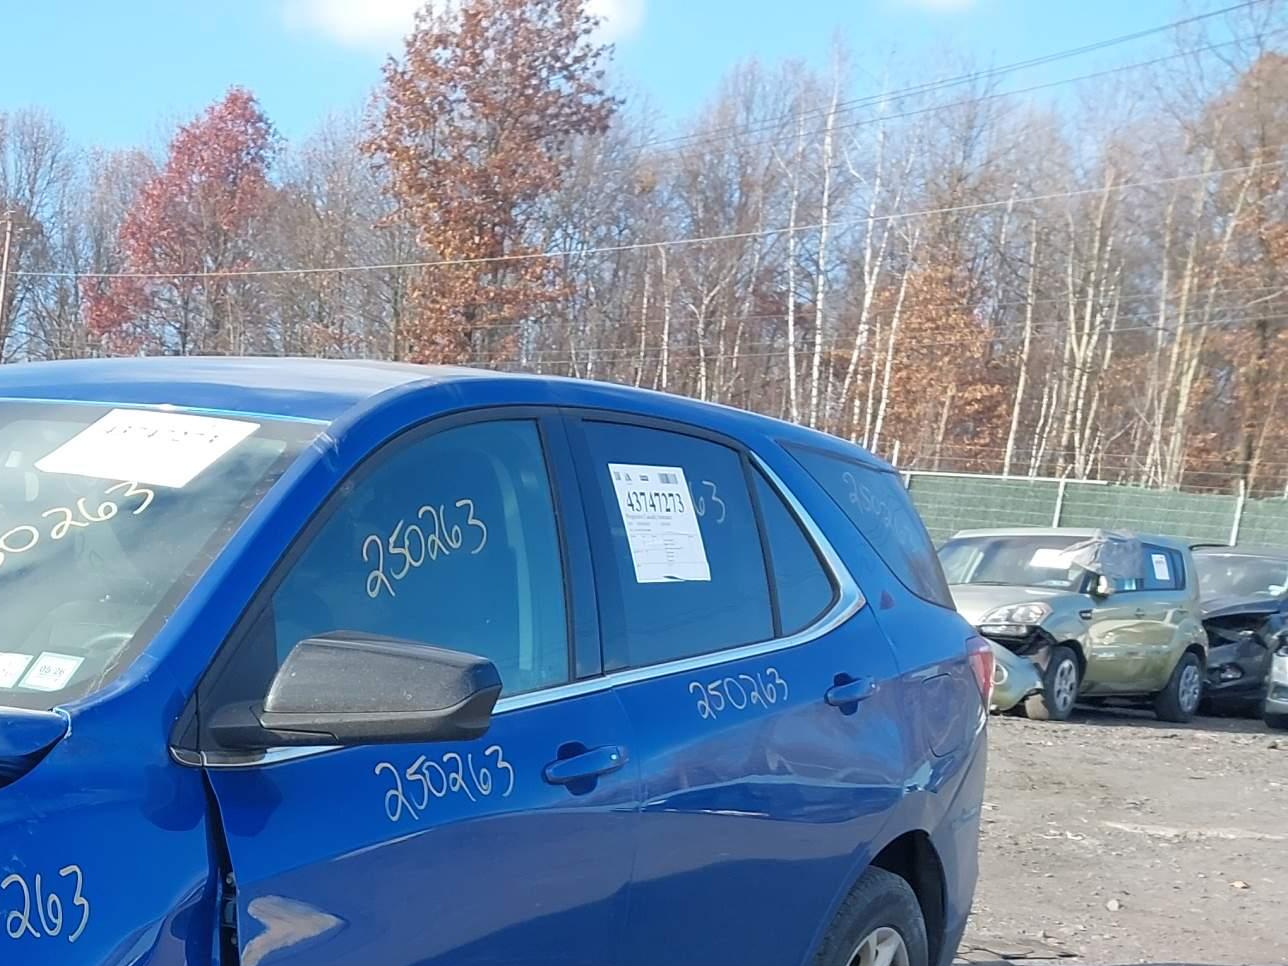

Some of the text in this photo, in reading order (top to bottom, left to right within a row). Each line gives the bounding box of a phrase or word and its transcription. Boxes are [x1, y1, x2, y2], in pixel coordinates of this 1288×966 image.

[626, 491, 685, 513] 43747273
[362, 499, 488, 598] 250263
[688, 667, 789, 720] 250263
[374, 745, 514, 822] 250263
